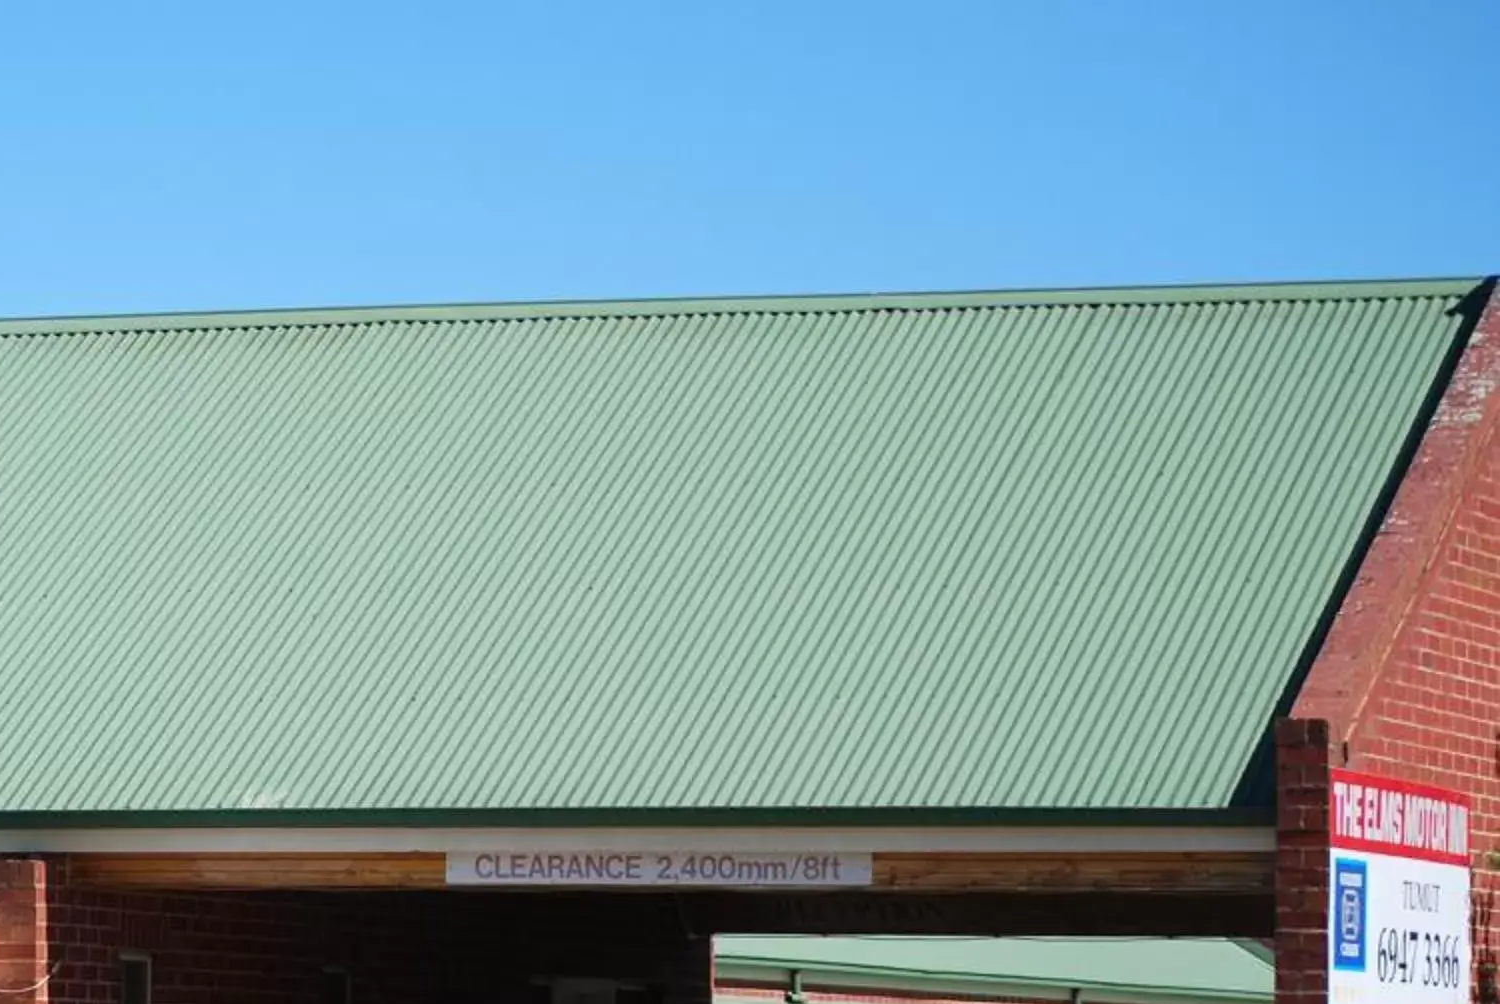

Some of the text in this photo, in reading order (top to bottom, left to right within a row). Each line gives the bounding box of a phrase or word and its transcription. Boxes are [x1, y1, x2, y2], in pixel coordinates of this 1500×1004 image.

[1334, 781, 1363, 838] THE
[474, 854, 842, 881] CLEARANCE 2,400mm/8ft
[1377, 927, 1461, 989] 6947 3366
